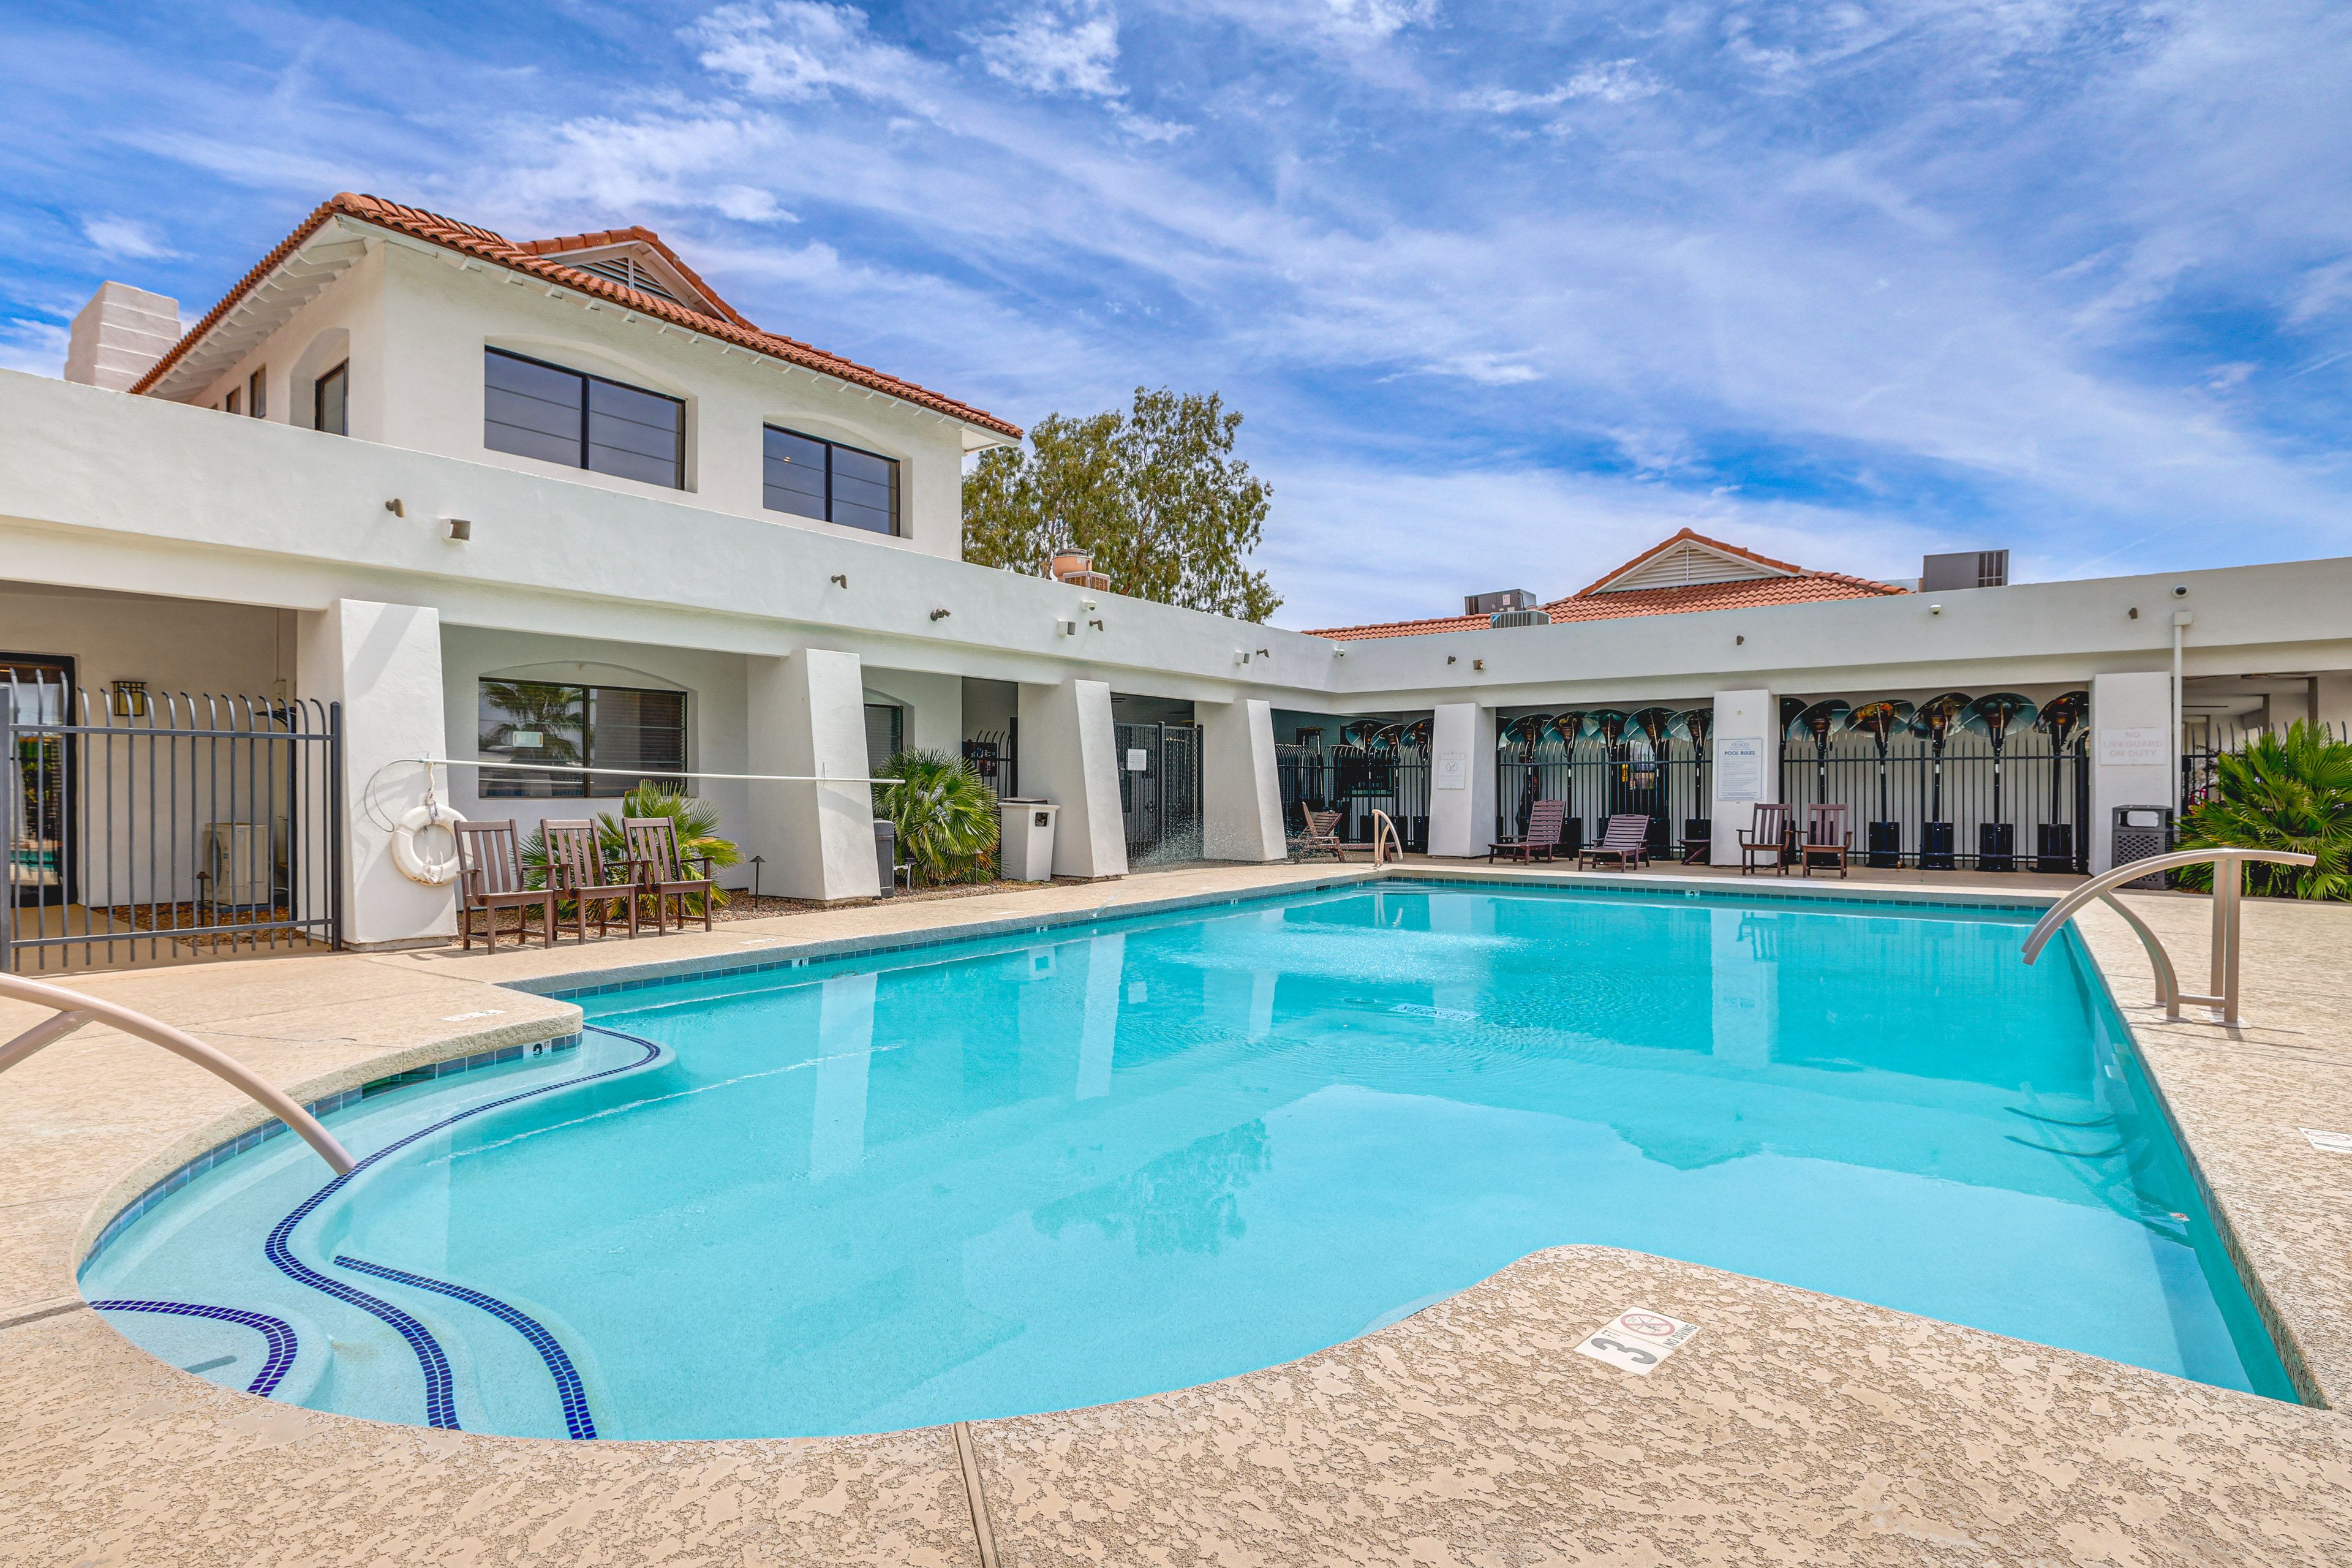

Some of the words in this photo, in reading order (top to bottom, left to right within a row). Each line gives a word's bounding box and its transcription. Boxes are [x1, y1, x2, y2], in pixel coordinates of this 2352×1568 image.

[1601, 1329, 1621, 1339] FT
[1663, 1338, 1675, 1347] NO
[1675, 1324, 1698, 1341] DIVING
[1591, 1337, 1658, 1365] 3
